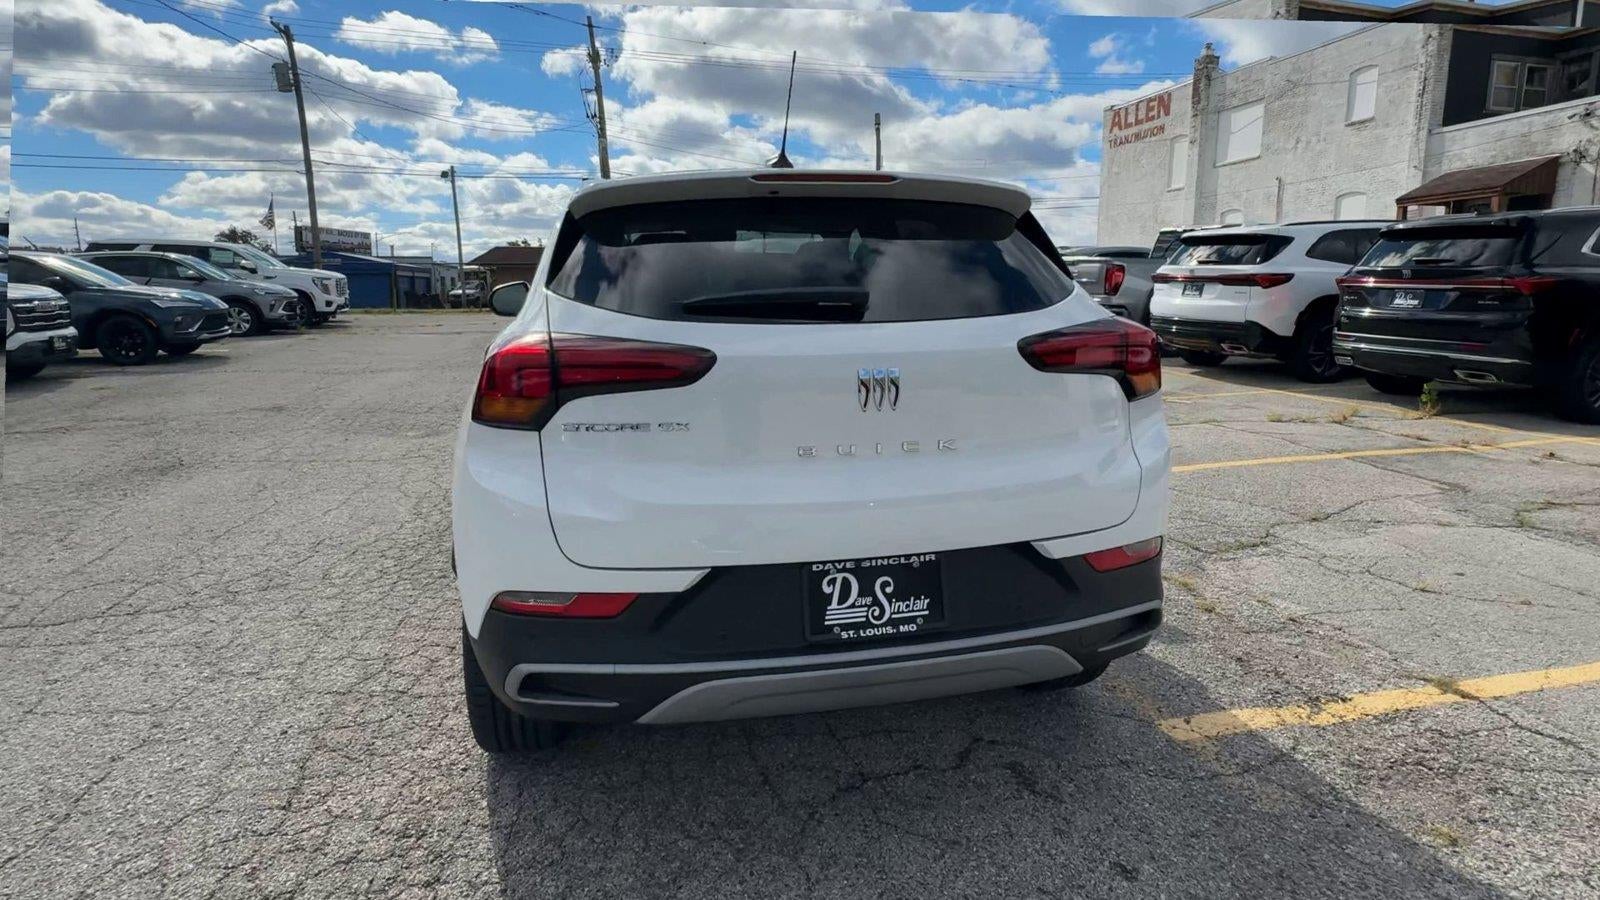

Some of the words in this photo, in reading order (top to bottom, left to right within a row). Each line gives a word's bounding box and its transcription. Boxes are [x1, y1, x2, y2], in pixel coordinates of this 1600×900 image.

[1109, 92, 1172, 133] ALLEN
[1108, 123, 1166, 149] TRANSMISSION
[797, 438, 957, 457] BUICK
[812, 561, 855, 572] DAVE
[861, 553, 936, 568] SINCLAIR
[822, 572, 873, 610] Dave
[868, 575, 930, 624] Sinclair
[841, 630, 857, 639] ST.
[900, 623, 917, 632] MO
